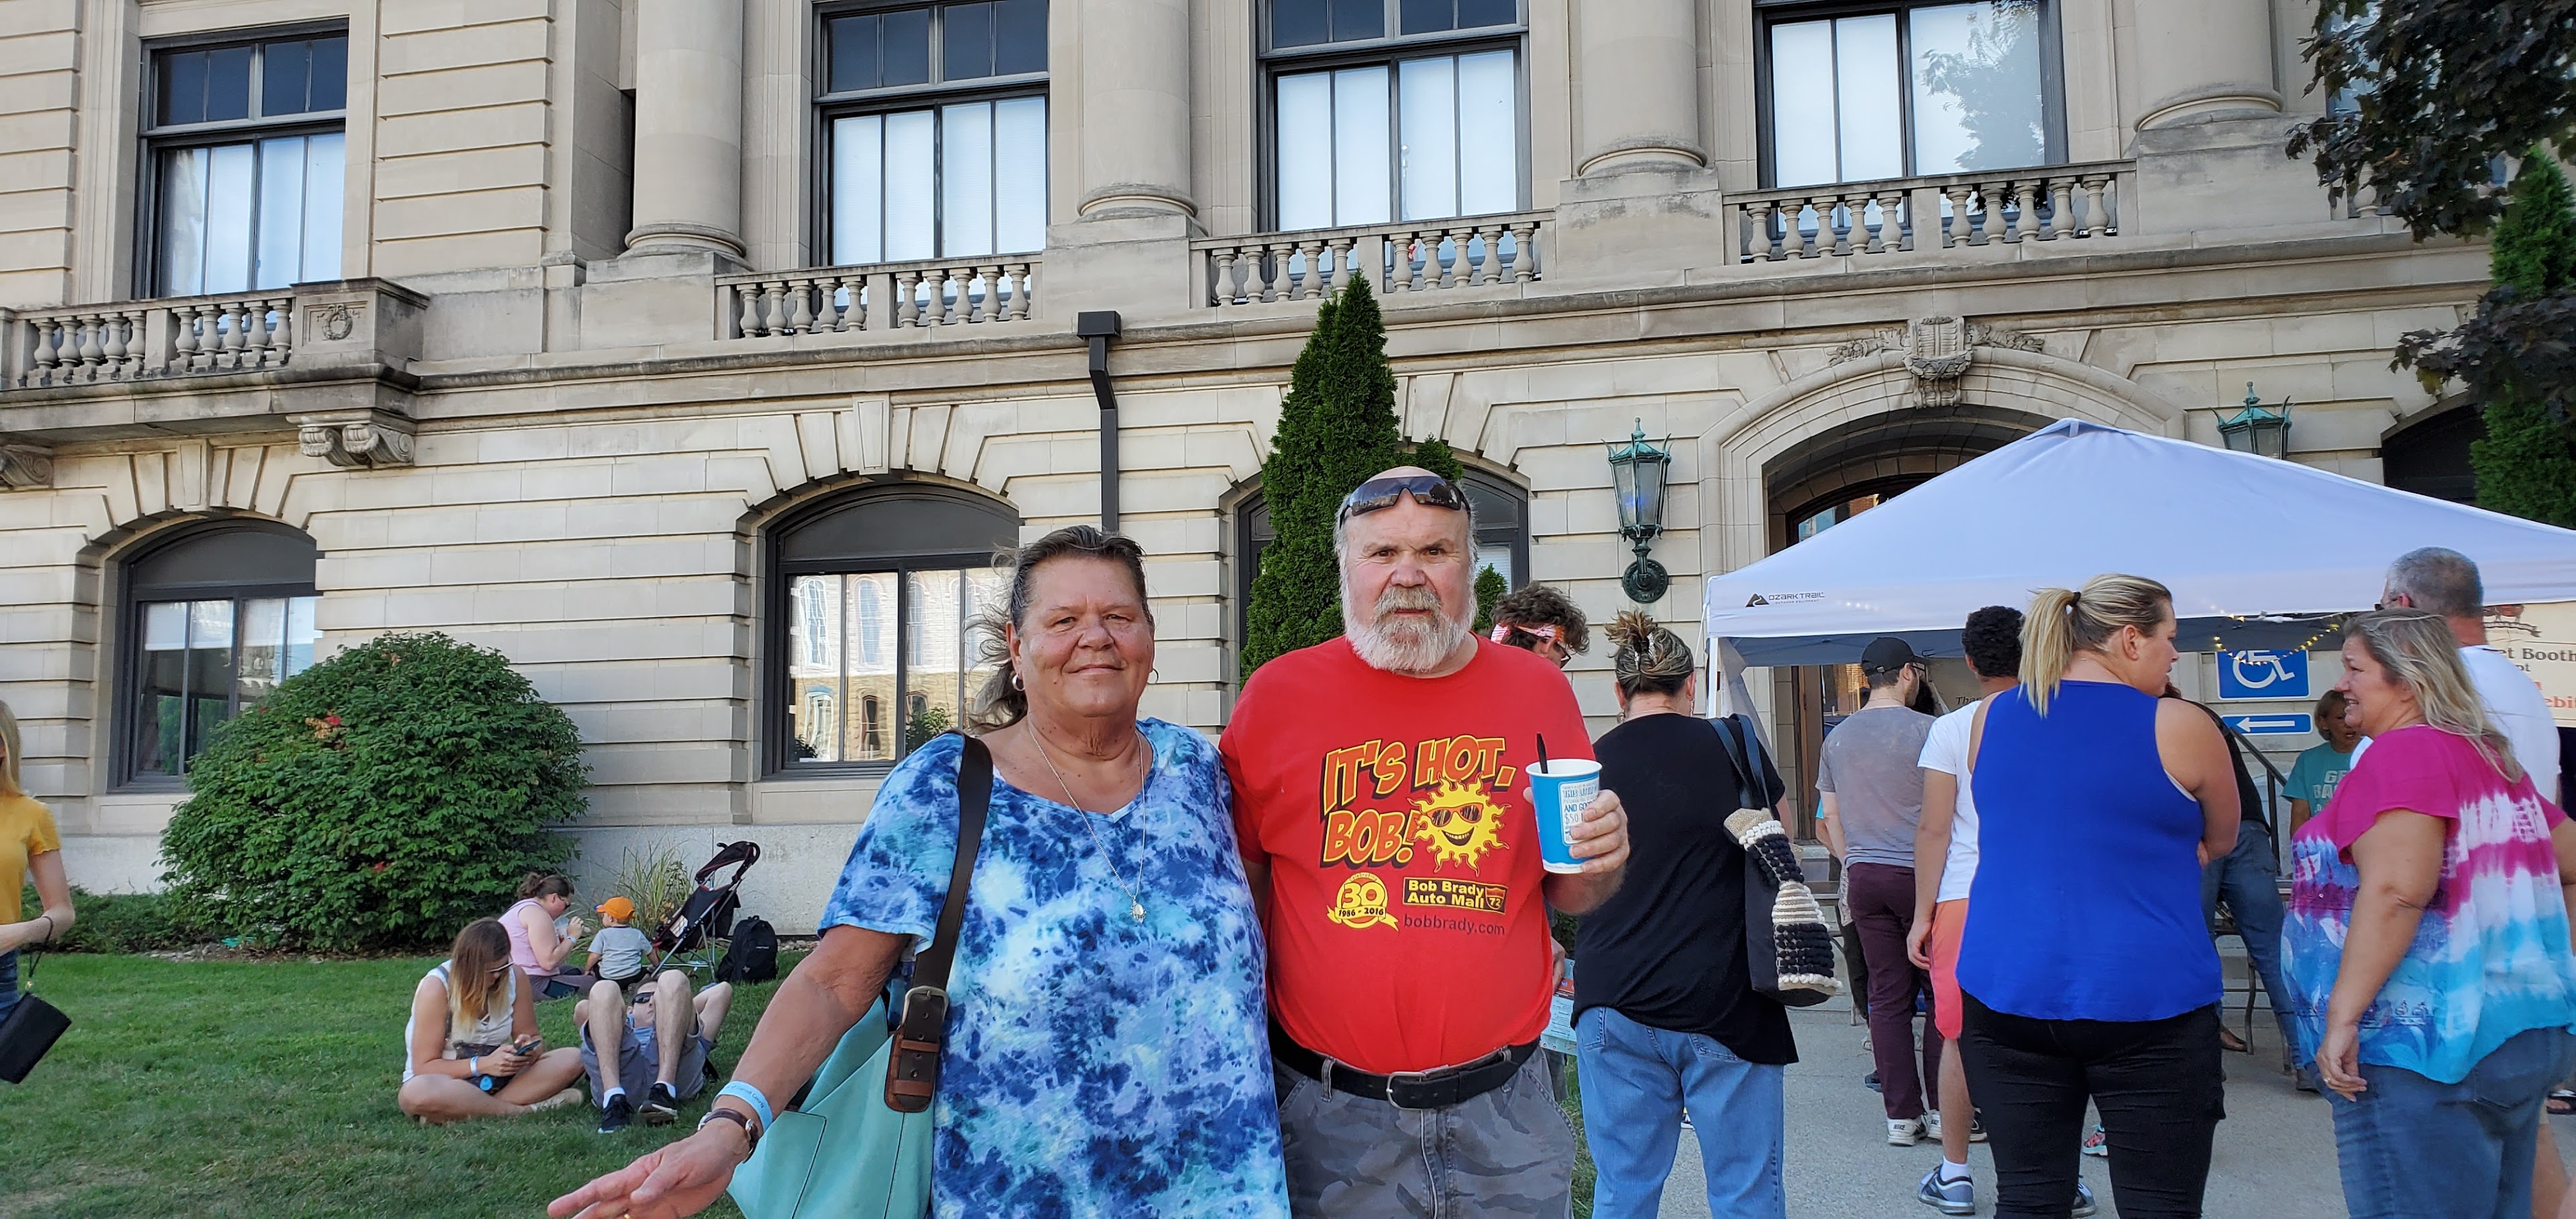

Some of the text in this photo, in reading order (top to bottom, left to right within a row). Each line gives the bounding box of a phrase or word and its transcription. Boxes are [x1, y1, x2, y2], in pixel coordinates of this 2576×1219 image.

[2522, 648, 2576, 661] Booth
[1323, 735, 1517, 816] IT'S HOT,
[1564, 804, 1577, 812] AND
[1323, 808, 1421, 864] BOB!
[1342, 882, 1386, 908] 30
[1409, 880, 1437, 892] Bob
[1442, 881, 1484, 898] Brady
[1407, 892, 1446, 904] Auto
[1451, 894, 1484, 909] Mall
[1489, 897, 1501, 906] 72
[1338, 909, 1356, 918] 1986
[1364, 907, 1384, 916] 2016
[1404, 913, 1505, 935] bobbrady.com
